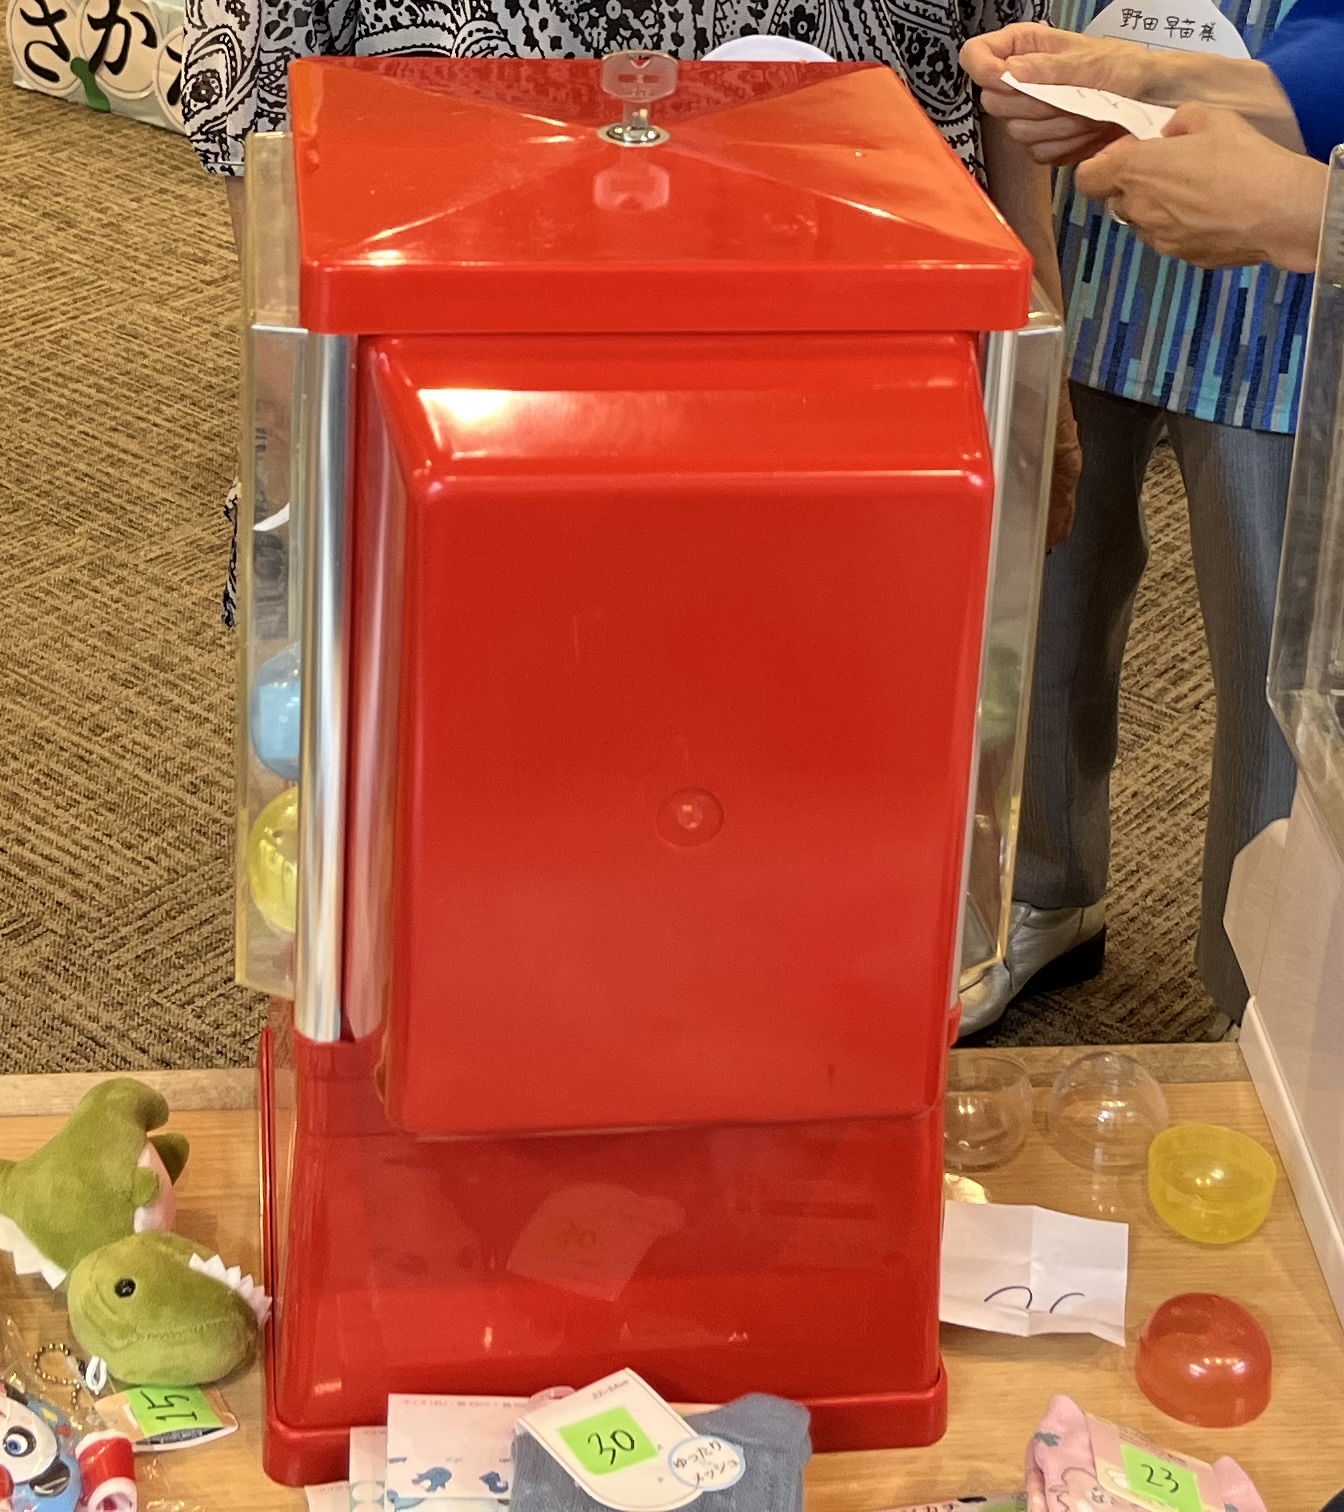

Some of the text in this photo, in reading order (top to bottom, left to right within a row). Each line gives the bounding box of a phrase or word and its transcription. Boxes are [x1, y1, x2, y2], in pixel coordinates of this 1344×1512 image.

[155, 1387, 200, 1425] 15
[586, 1428, 636, 1467] 30
[673, 1439, 723, 1471] ゆったり
[1139, 1461, 1181, 1494] 23
